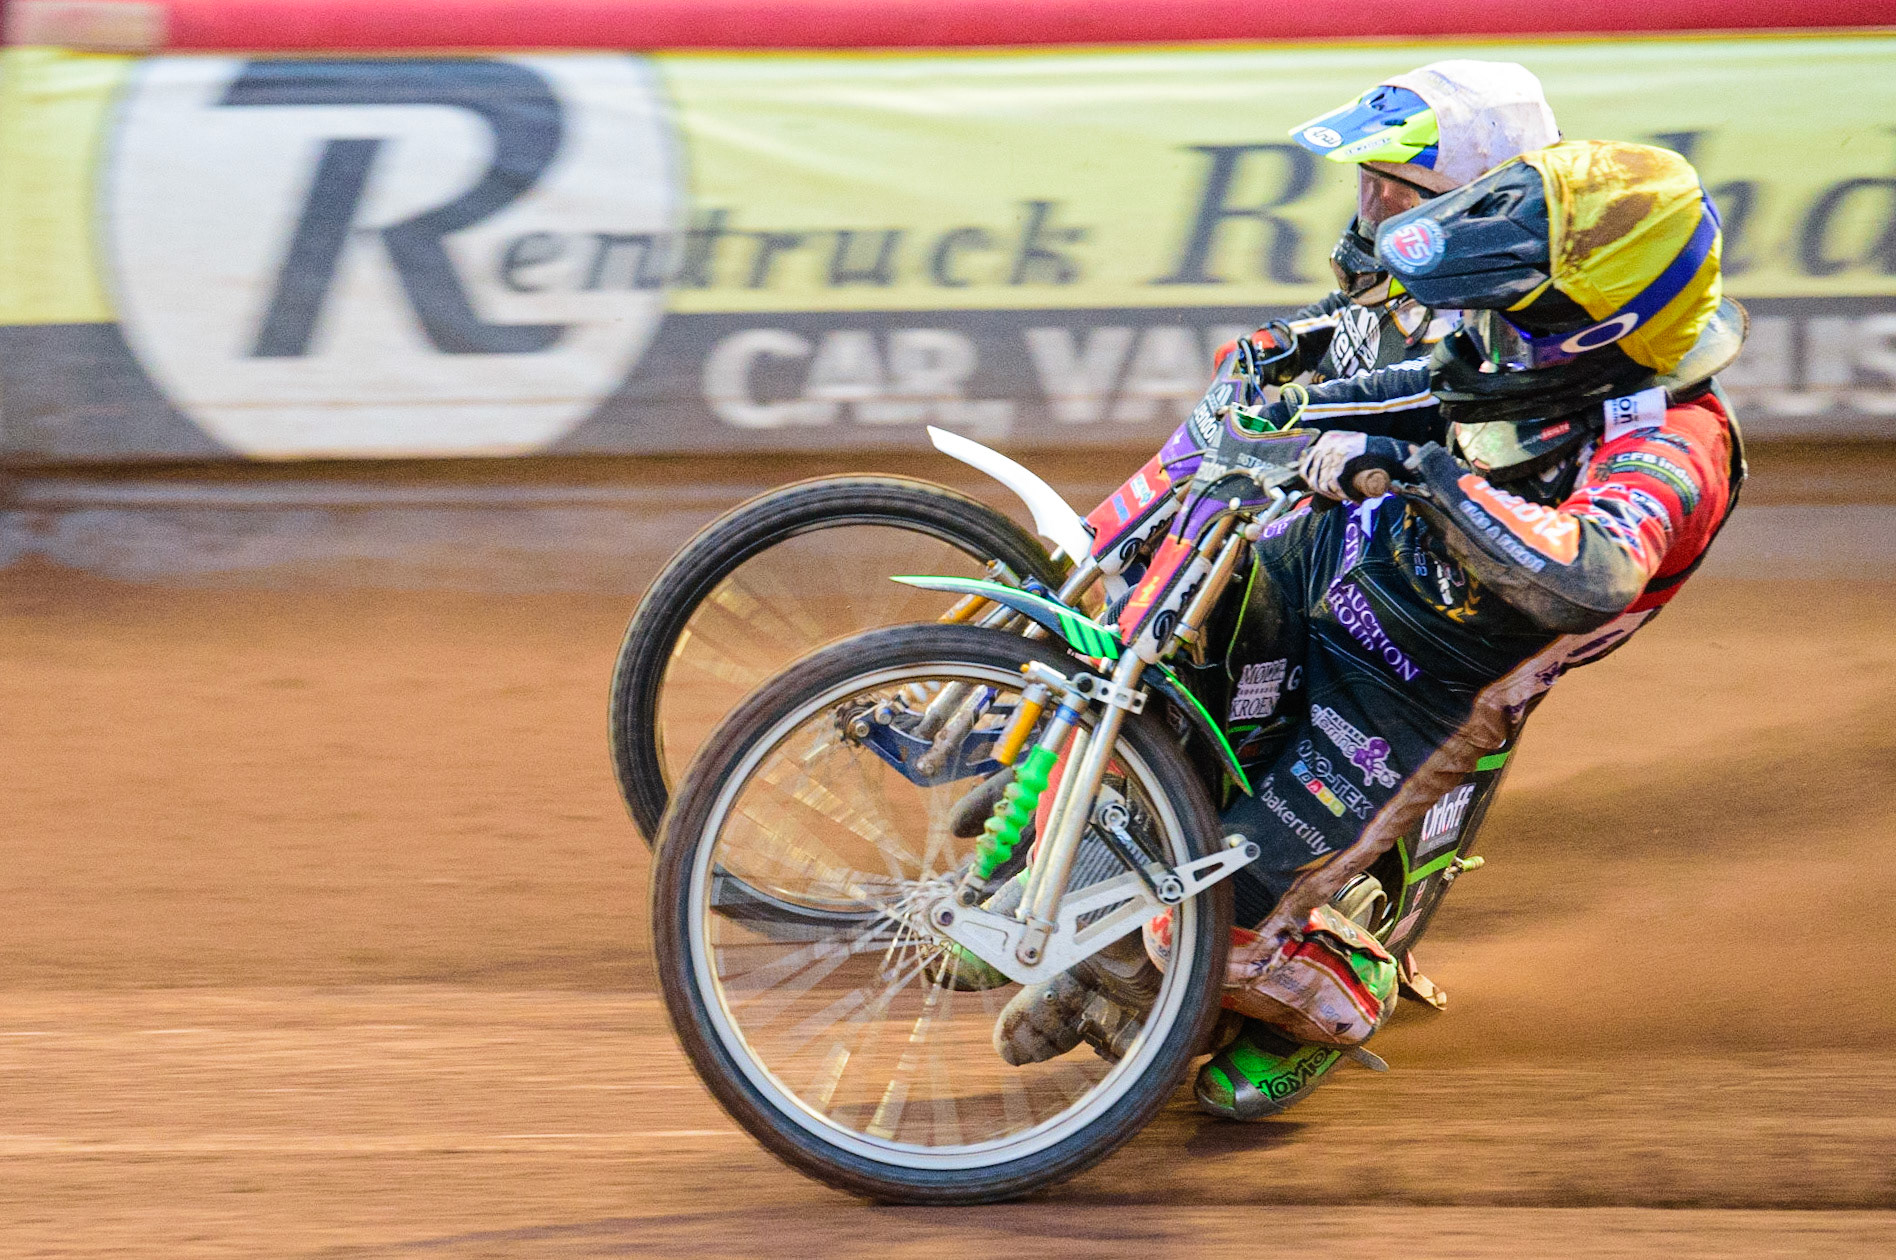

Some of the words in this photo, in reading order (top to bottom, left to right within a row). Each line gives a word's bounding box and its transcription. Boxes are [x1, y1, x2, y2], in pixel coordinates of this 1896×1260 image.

[1394, 225, 1431, 260] STS
[1341, 583, 1421, 682] AUCTION
[1261, 787, 1332, 856] bakertilly
